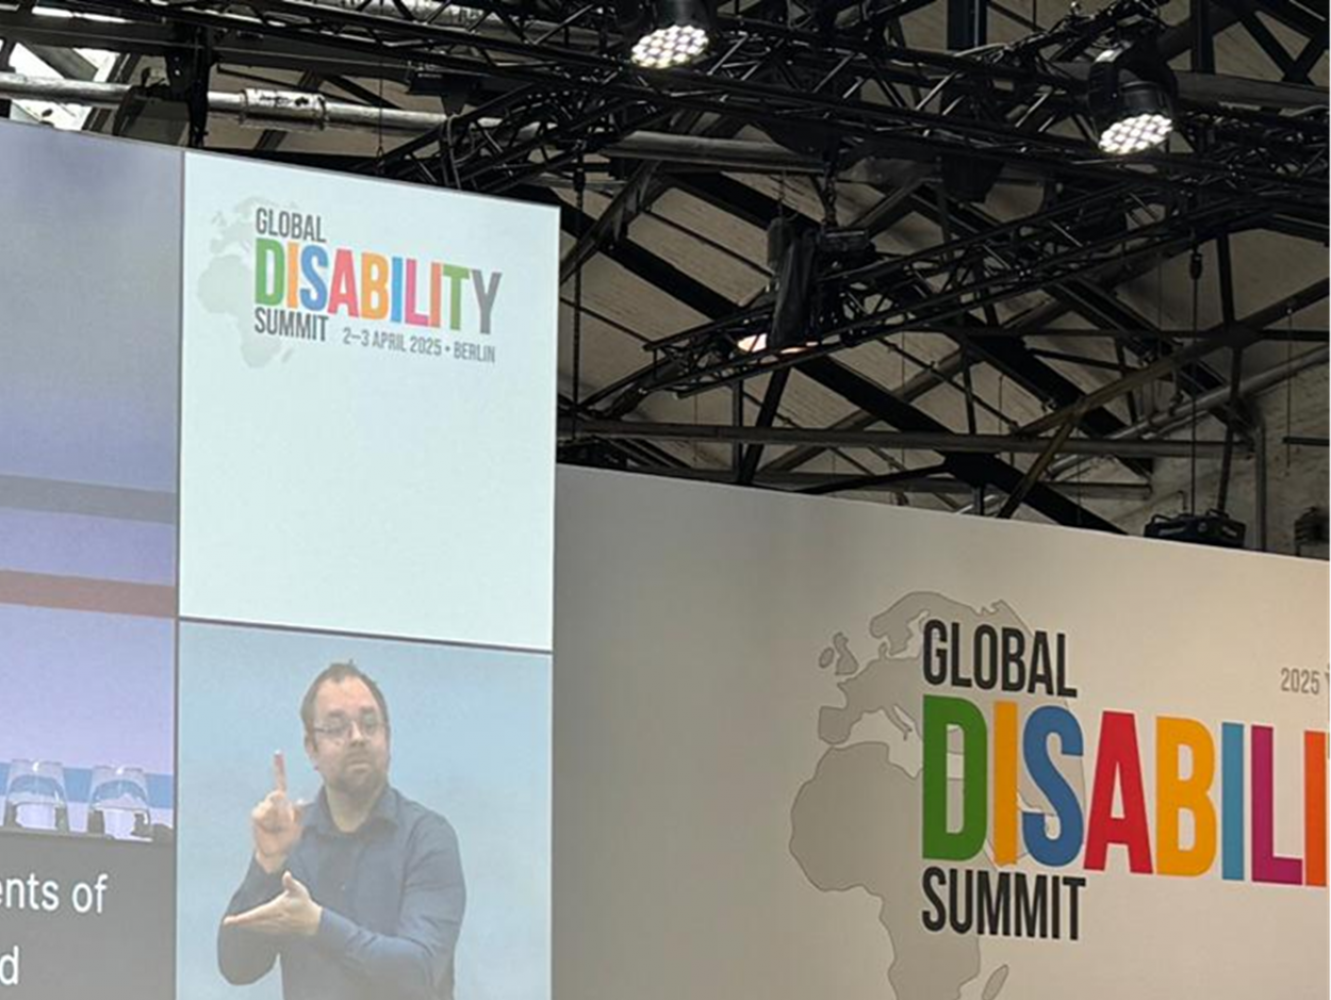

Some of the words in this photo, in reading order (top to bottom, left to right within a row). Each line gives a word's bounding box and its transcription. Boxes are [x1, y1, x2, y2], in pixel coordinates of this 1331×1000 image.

[255, 207, 326, 243] GLOBAL
[254, 237, 503, 335] DISABILITY
[254, 307, 329, 342] SUMMIT
[371, 333, 407, 353] APRIL
[410, 336, 442, 356] 2025
[453, 342, 496, 363] BERLIN
[922, 619, 1078, 698] GLOBAL
[1280, 667, 1321, 696] 2025
[922, 694, 1331, 888] DISABILI
[71, 873, 108, 914] of
[922, 867, 1086, 941] SUMMIT
